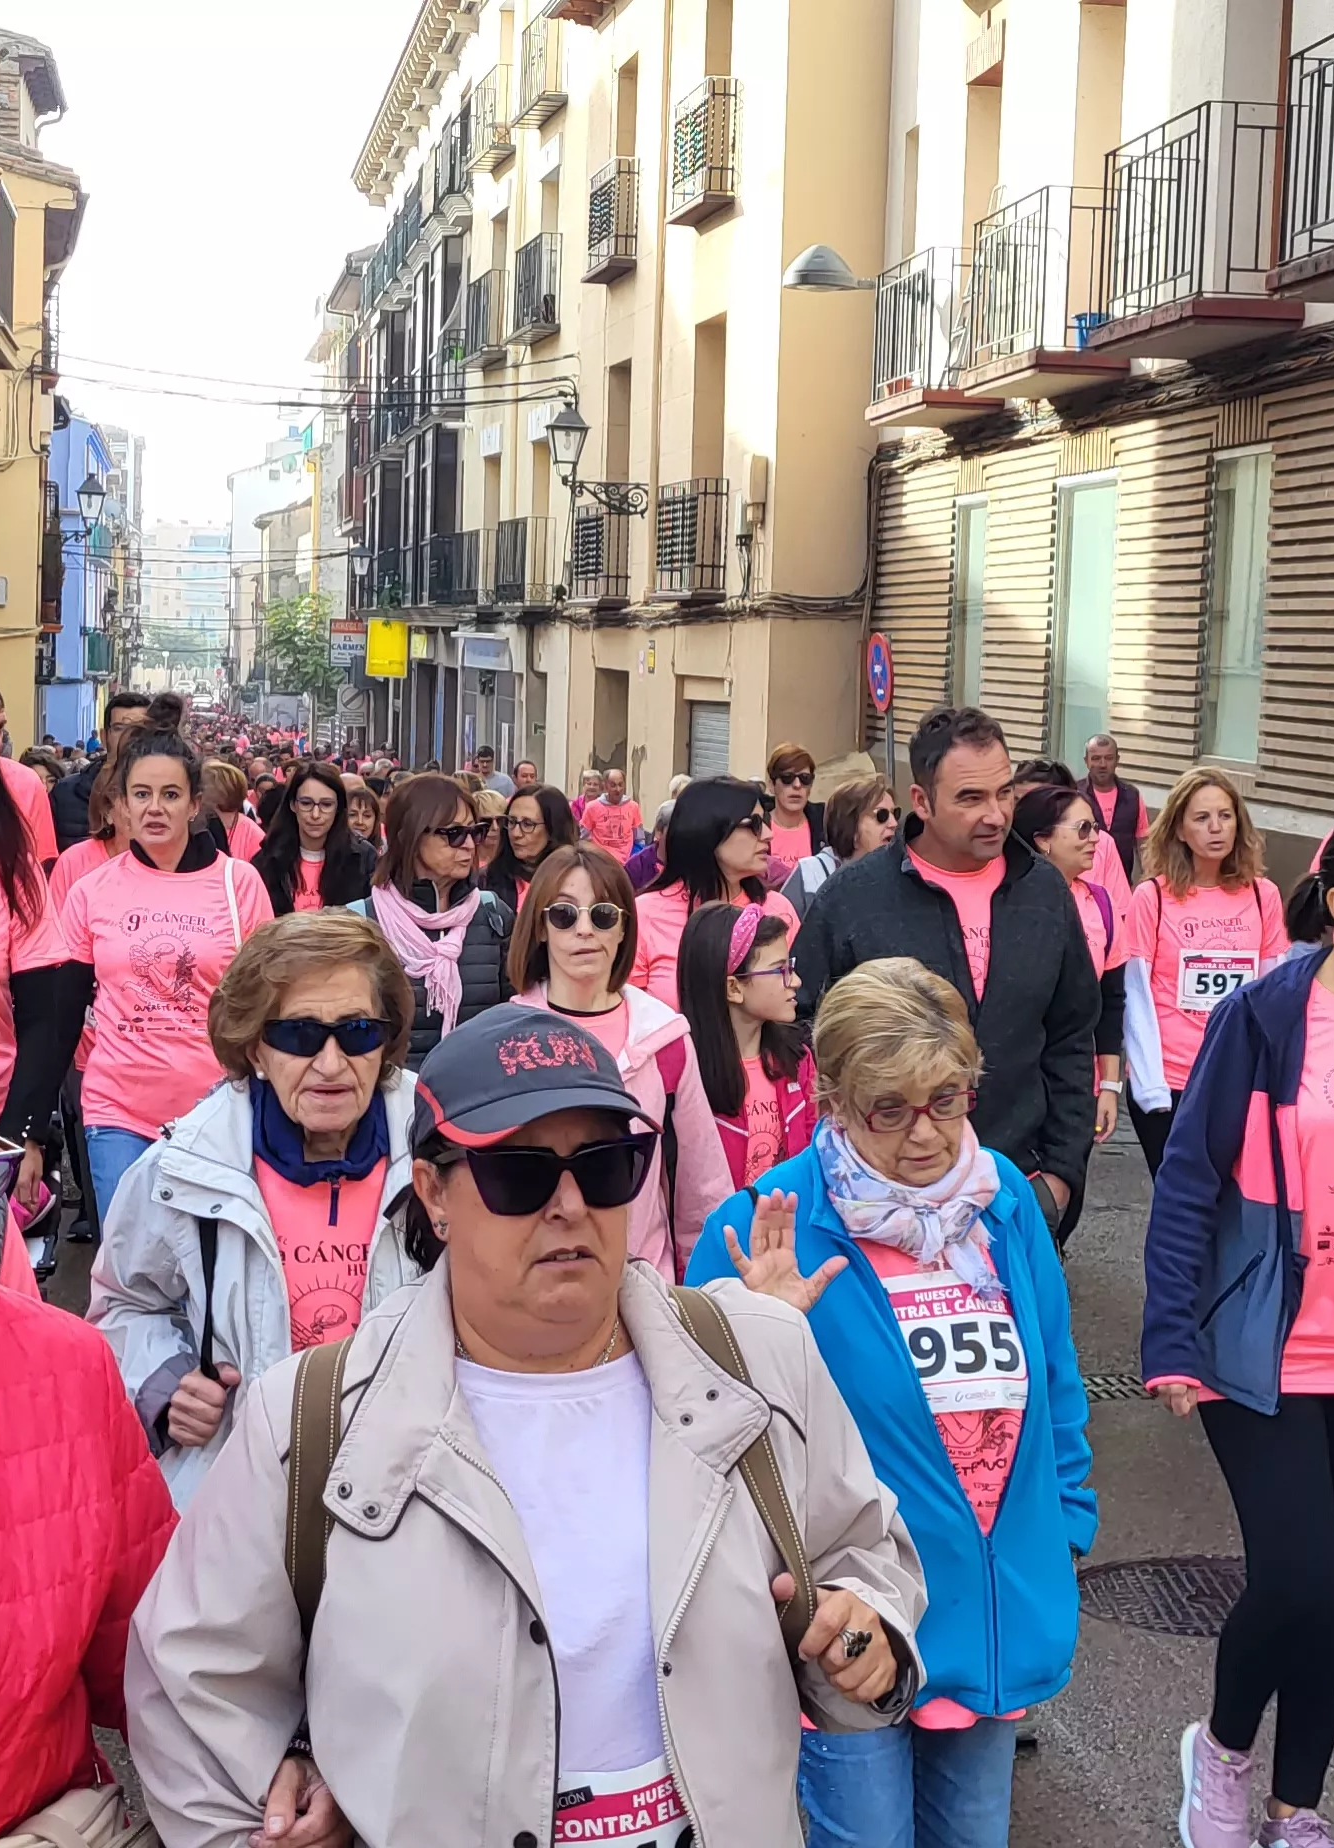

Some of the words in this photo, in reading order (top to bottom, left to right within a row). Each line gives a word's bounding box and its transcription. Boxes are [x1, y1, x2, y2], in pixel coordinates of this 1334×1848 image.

[152, 911, 206, 927] CÁNCER
[1201, 917, 1243, 929] CÁNCER
[178, 924, 215, 937] HUESCA
[1194, 972, 1245, 996] 597
[496, 1031, 598, 1077] RUN
[746, 1100, 779, 1116] CÁNC
[294, 1240, 370, 1264] CÁNCE
[914, 1287, 963, 1303] HUESCA
[932, 1302, 952, 1316] EL
[954, 1295, 1008, 1314] CÁNCER
[908, 1321, 1021, 1379] 955
[632, 1779, 673, 1808] HUES
[656, 1800, 681, 1822] EL
